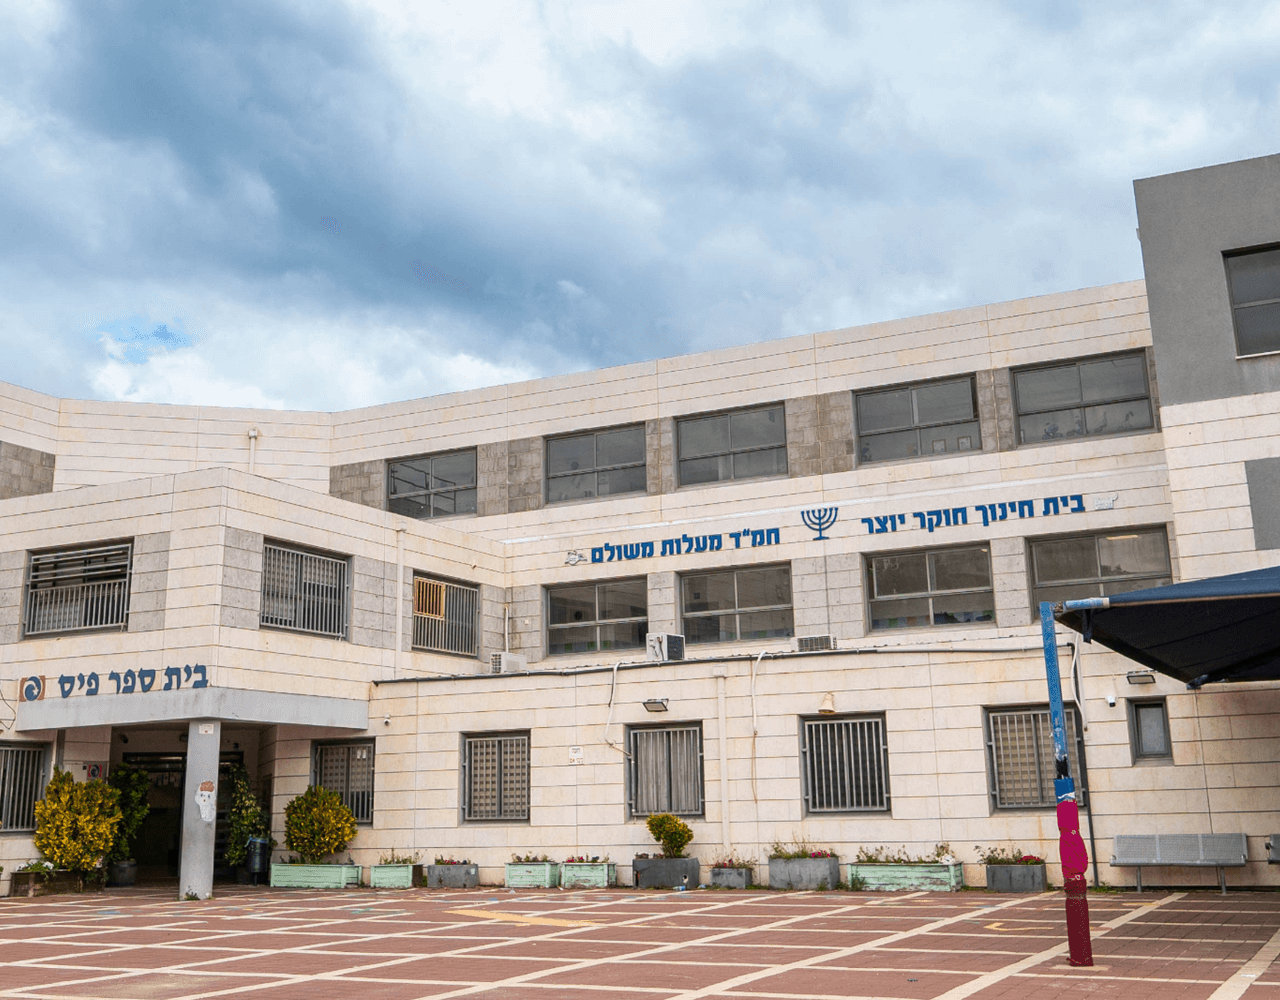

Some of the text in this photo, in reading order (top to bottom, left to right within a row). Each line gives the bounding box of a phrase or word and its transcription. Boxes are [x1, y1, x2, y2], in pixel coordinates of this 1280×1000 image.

[861, 495, 1086, 534] בית חינוך חוקר יוצר
[591, 542, 654, 563] משולם
[660, 534, 723, 557] מעלות
[57, 663, 209, 699] בית ספר פיס
